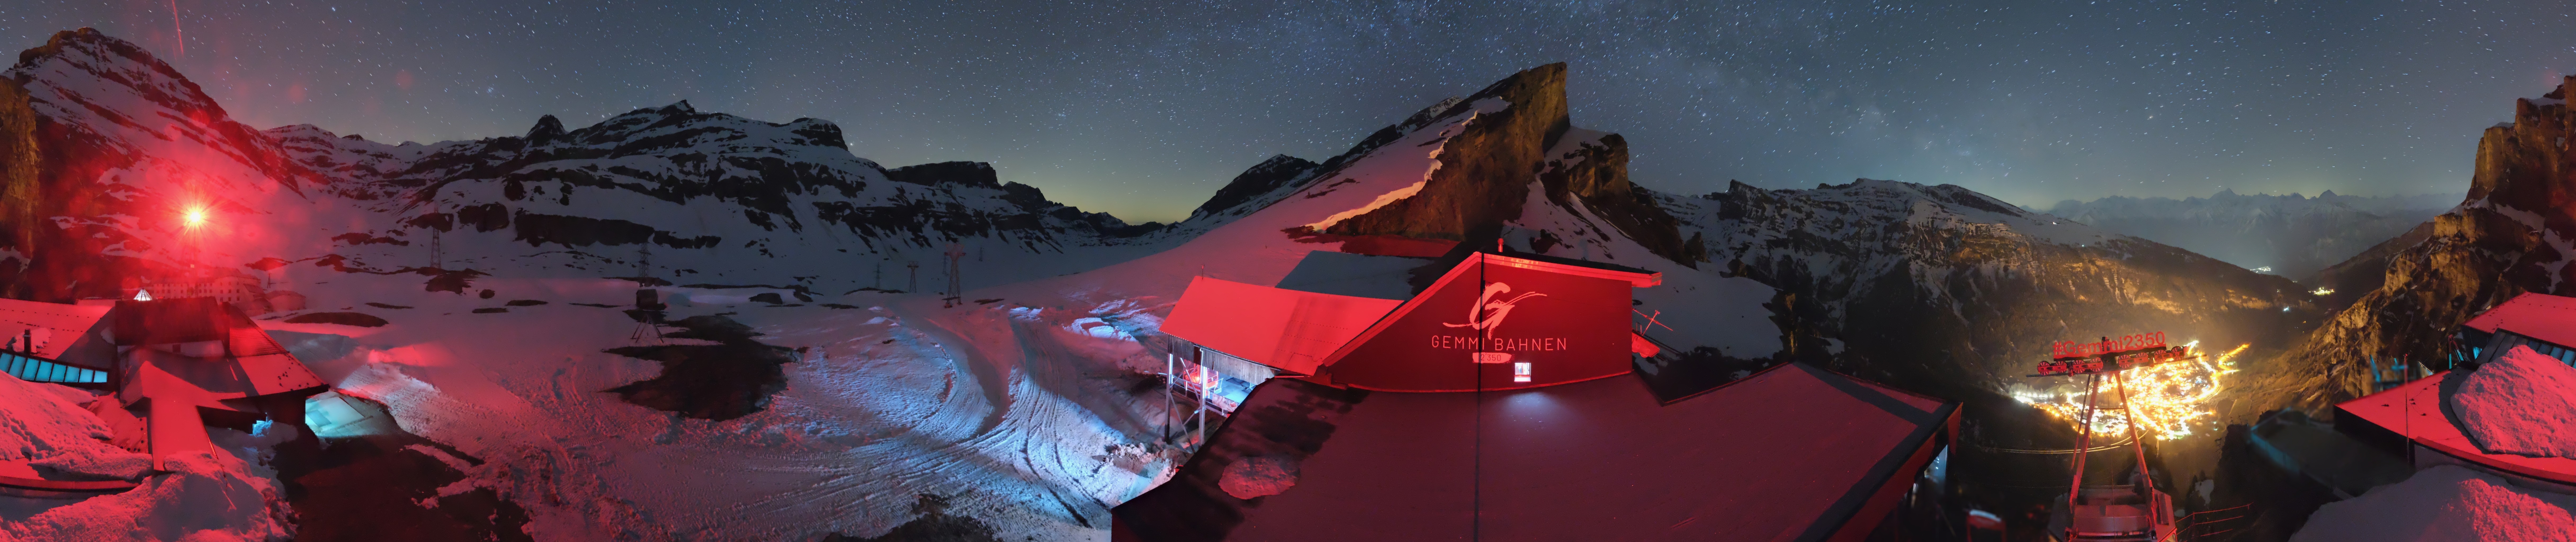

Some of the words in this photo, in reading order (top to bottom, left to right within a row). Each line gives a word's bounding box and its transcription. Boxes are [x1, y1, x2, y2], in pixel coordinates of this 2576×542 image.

[1432, 335, 1484, 350] GEMMI
[1495, 338, 1566, 351] BAHNEN
[2053, 331, 2165, 355] #Gemmi2350
